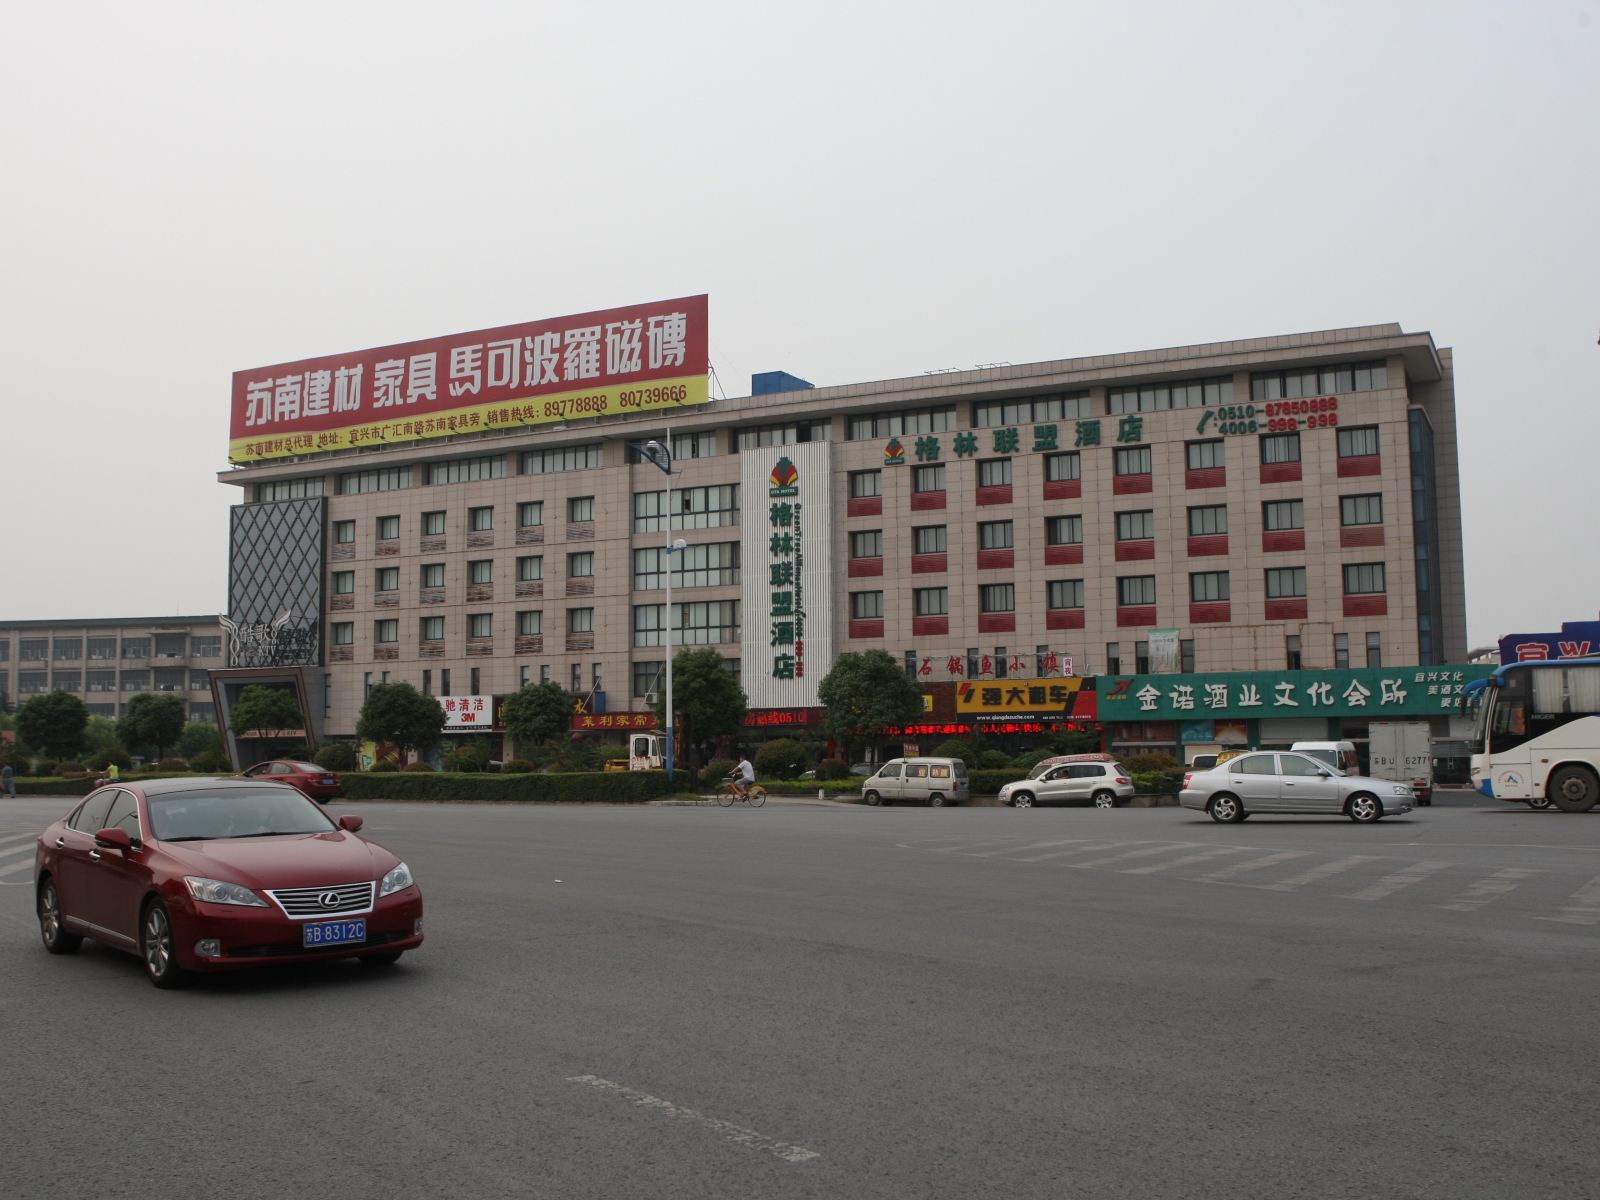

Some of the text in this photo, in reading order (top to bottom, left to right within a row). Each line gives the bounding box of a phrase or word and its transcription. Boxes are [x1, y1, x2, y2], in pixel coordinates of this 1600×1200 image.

[246, 312, 687, 427] 苏南建材 家具 馬可波羅磁磚
[245, 435, 313, 456] 苏南建材总代理
[619, 384, 687, 408] 80739666
[914, 415, 1143, 461] 格林联盟酒店
[769, 502, 794, 679] 格林联盟酒店
[461, 712, 476, 723] 3M
[1135, 678, 1408, 711] 金诺酒业文化会所
